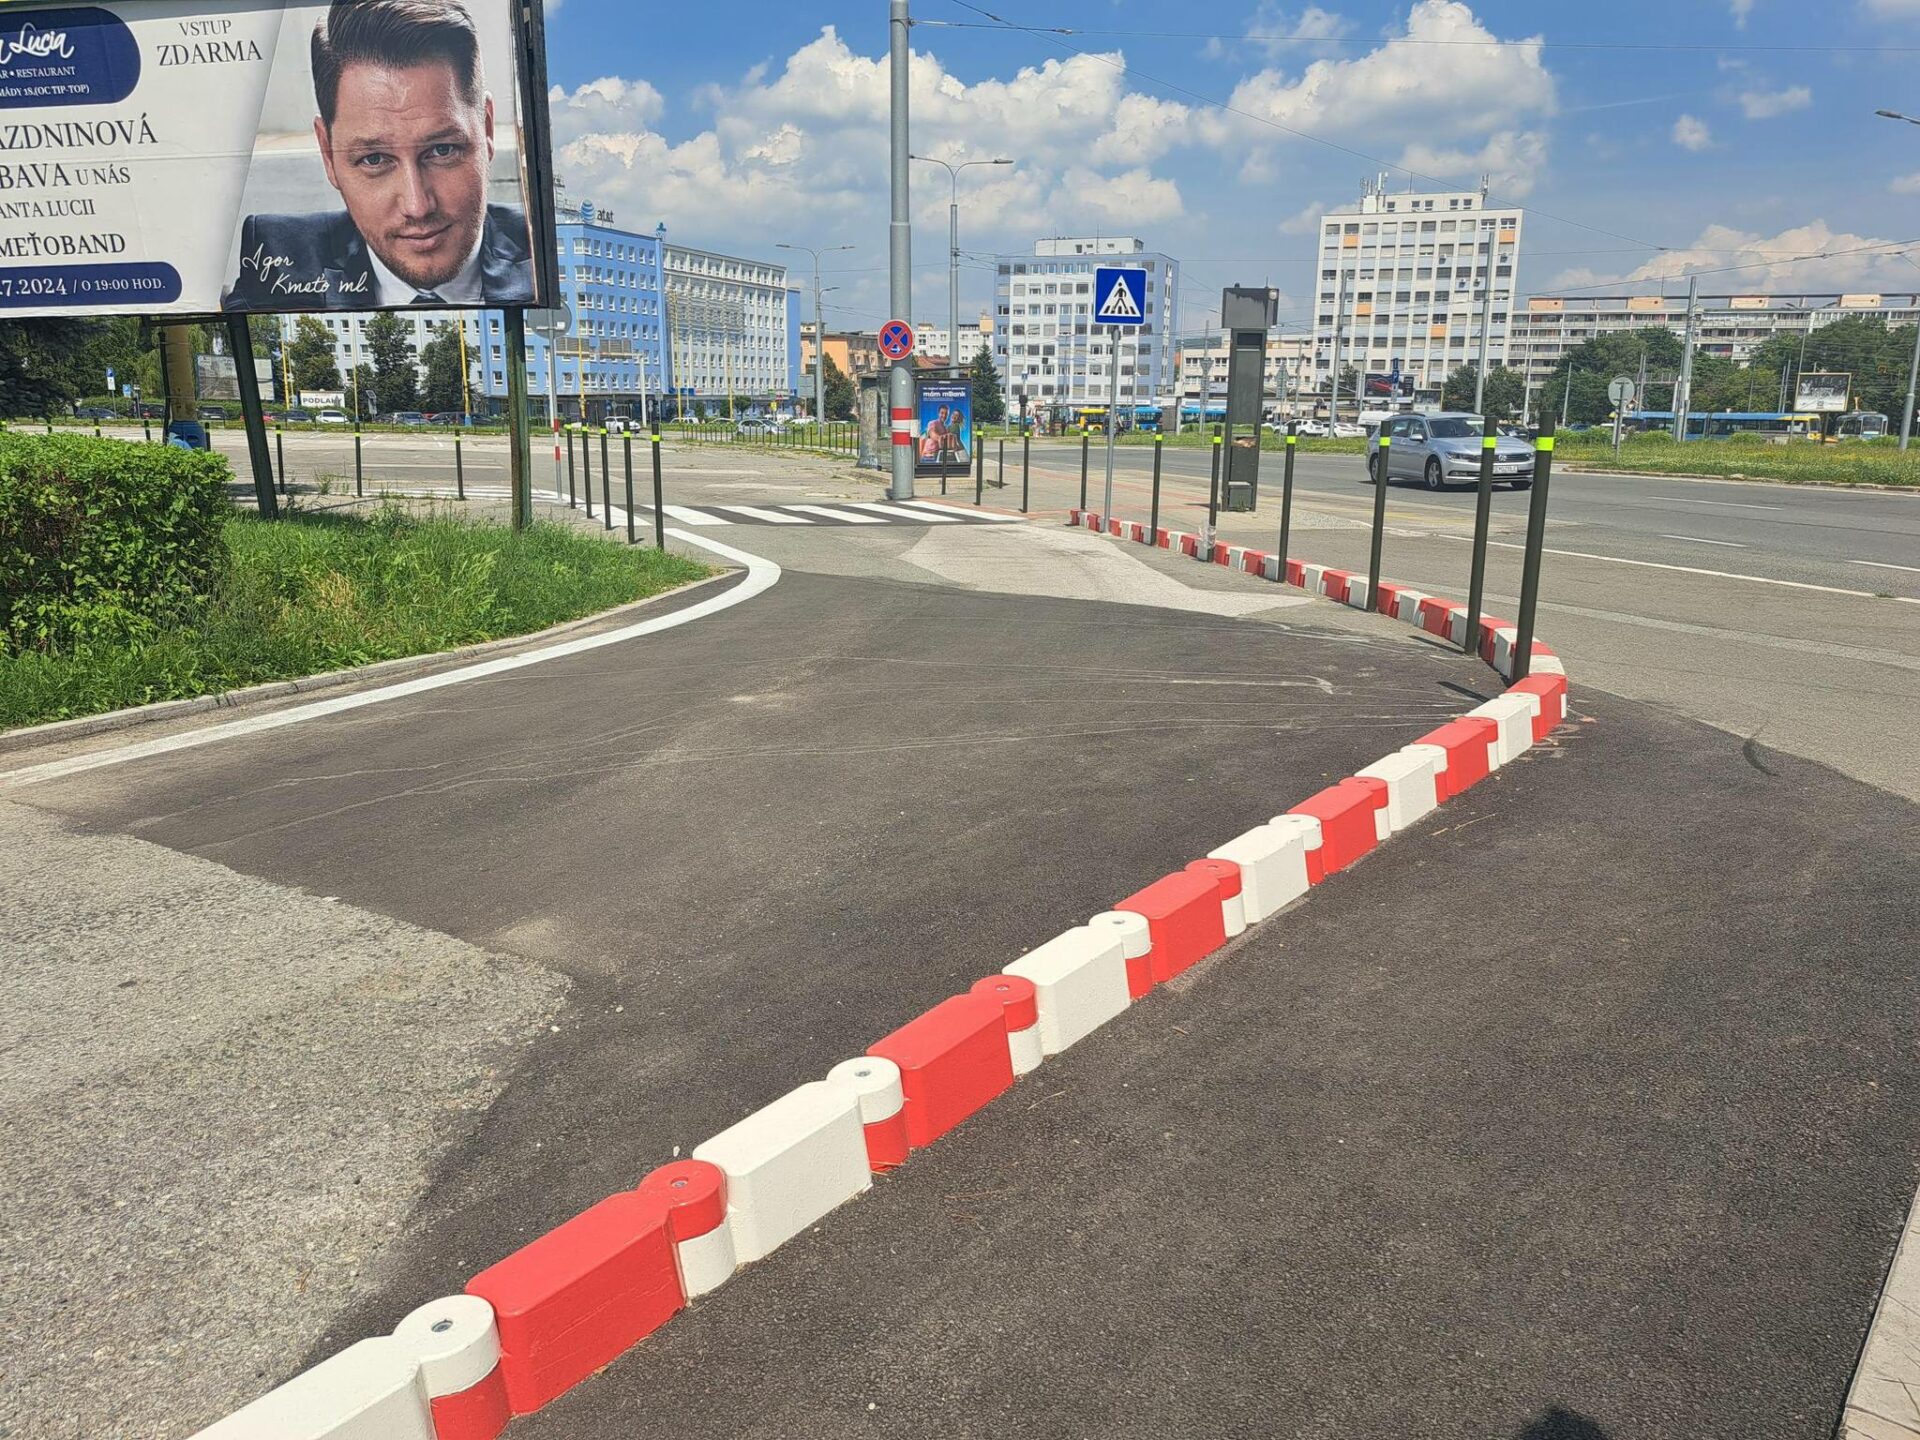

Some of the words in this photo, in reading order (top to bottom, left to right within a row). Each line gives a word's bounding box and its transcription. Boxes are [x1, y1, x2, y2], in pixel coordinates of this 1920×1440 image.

[179, 20, 231, 36] VSTUP
[9, 22, 74, 58] Lucia
[157, 40, 263, 66] ZDARMA
[16, 66, 76, 78] RESTAURANT
[51, 84, 90, 94] TIP-TOP)
[0, 162, 71, 190] BAVA
[75, 168, 88, 185] U
[94, 164, 131, 185] NÁS
[46, 199, 96, 217] LUCII
[242, 242, 294, 282] Igor
[94, 279, 129, 291] 19:00
[132, 278, 166, 290] HOD.
[339, 271, 369, 293] ml.
